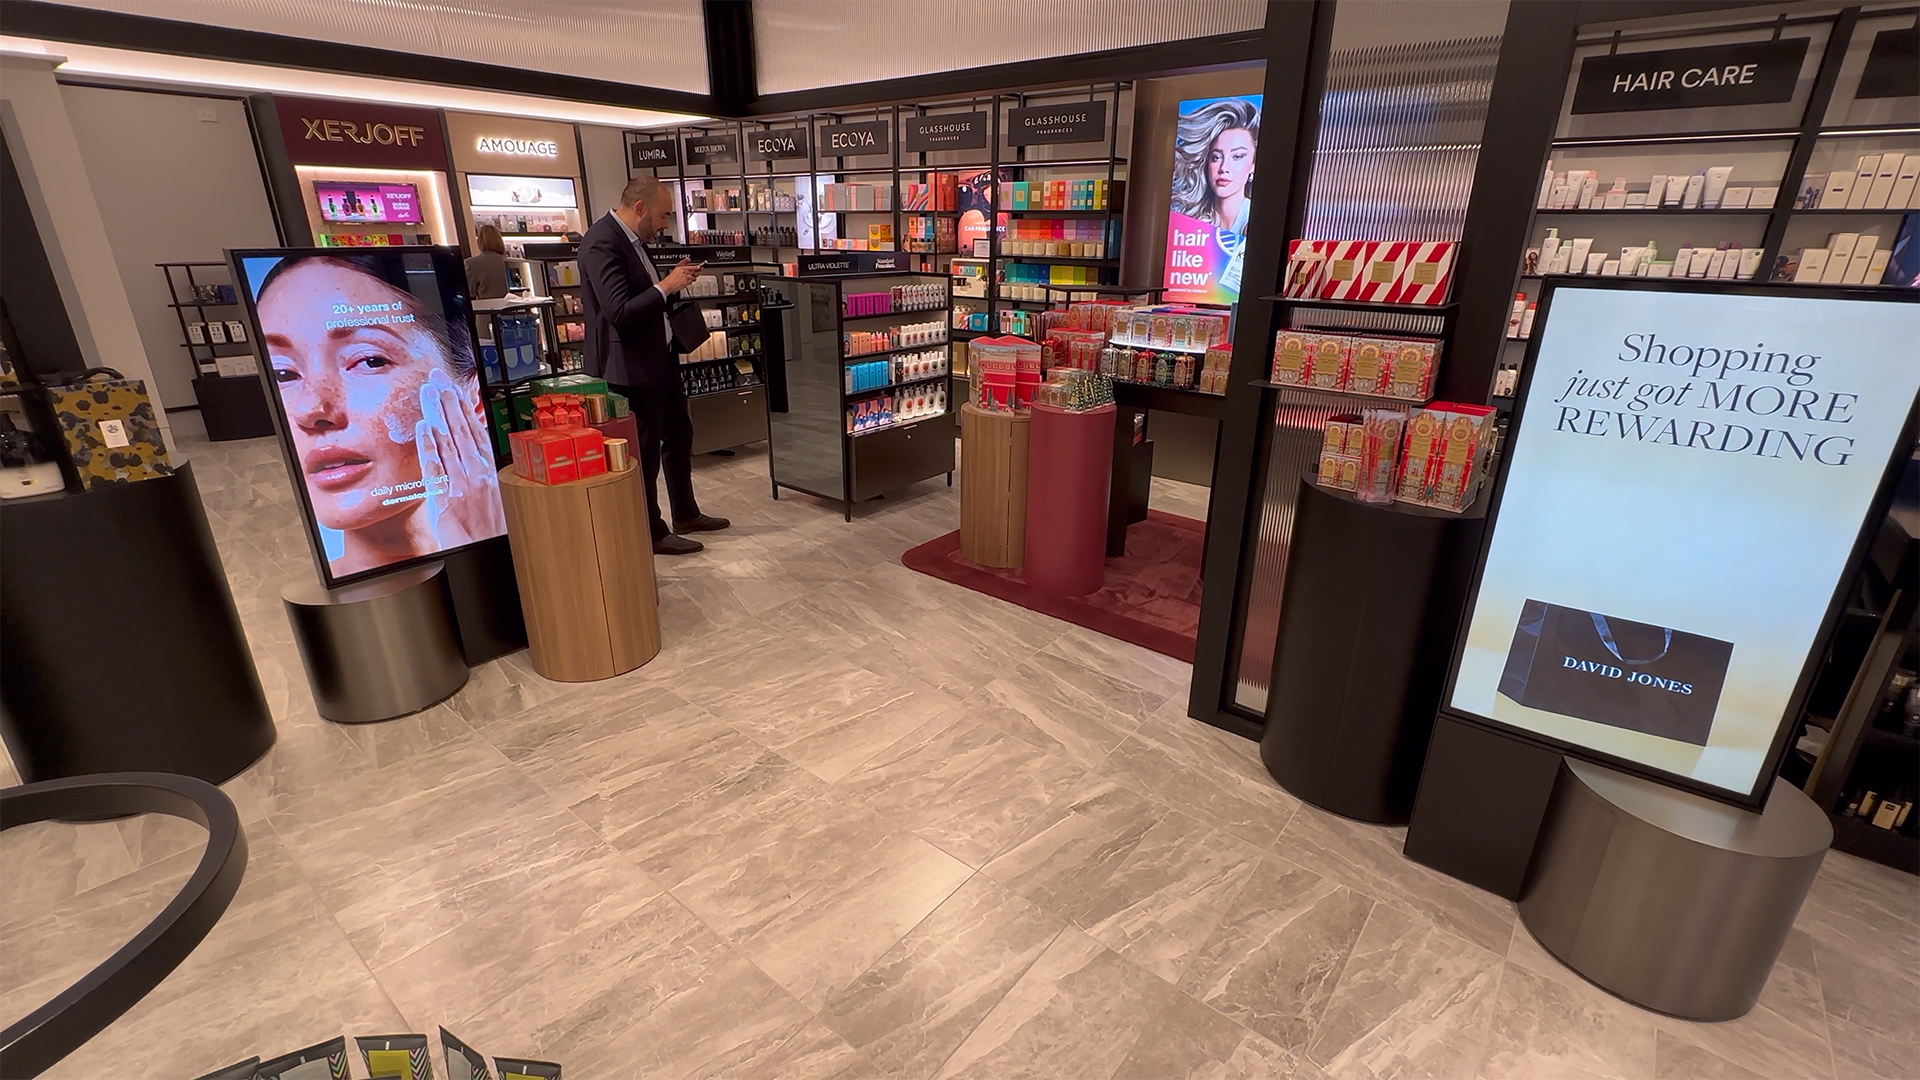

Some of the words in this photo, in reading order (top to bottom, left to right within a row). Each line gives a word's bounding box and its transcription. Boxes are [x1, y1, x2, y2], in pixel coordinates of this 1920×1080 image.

[1612, 70, 1674, 93] HAIR
[1680, 63, 1758, 89] CARE
[919, 122, 971, 135] GLASSHOUSE
[1024, 113, 1087, 127] GLASSHOUSE
[301, 118, 423, 146] XERJOFF
[832, 131, 875, 149] ECOYA
[1036, 127, 1073, 135] FRAGRANCES
[479, 138, 558, 155] AMOUAGE
[758, 137, 796, 153] ECOYA
[1173, 229, 1210, 247] hair
[808, 262, 825, 270] ULTRA
[826, 261, 851, 269] VIOLETTE
[1171, 250, 1203, 268] like
[332, 304, 355, 315] 20+
[358, 302, 390, 315] years
[391, 300, 403, 311] of
[325, 314, 390, 331] professional
[391, 313, 416, 324] trust
[1617, 332, 1822, 387] Shopping
[1554, 369, 1630, 404] just
[1627, 382, 1693, 412] got
[1696, 381, 1859, 424] MORE
[1553, 405, 1856, 467] REWARDING
[370, 484, 394, 497] daily
[382, 488, 444, 506] dermalogica
[1562, 656, 1622, 679] DAVID
[1627, 671, 1693, 695] JONES
